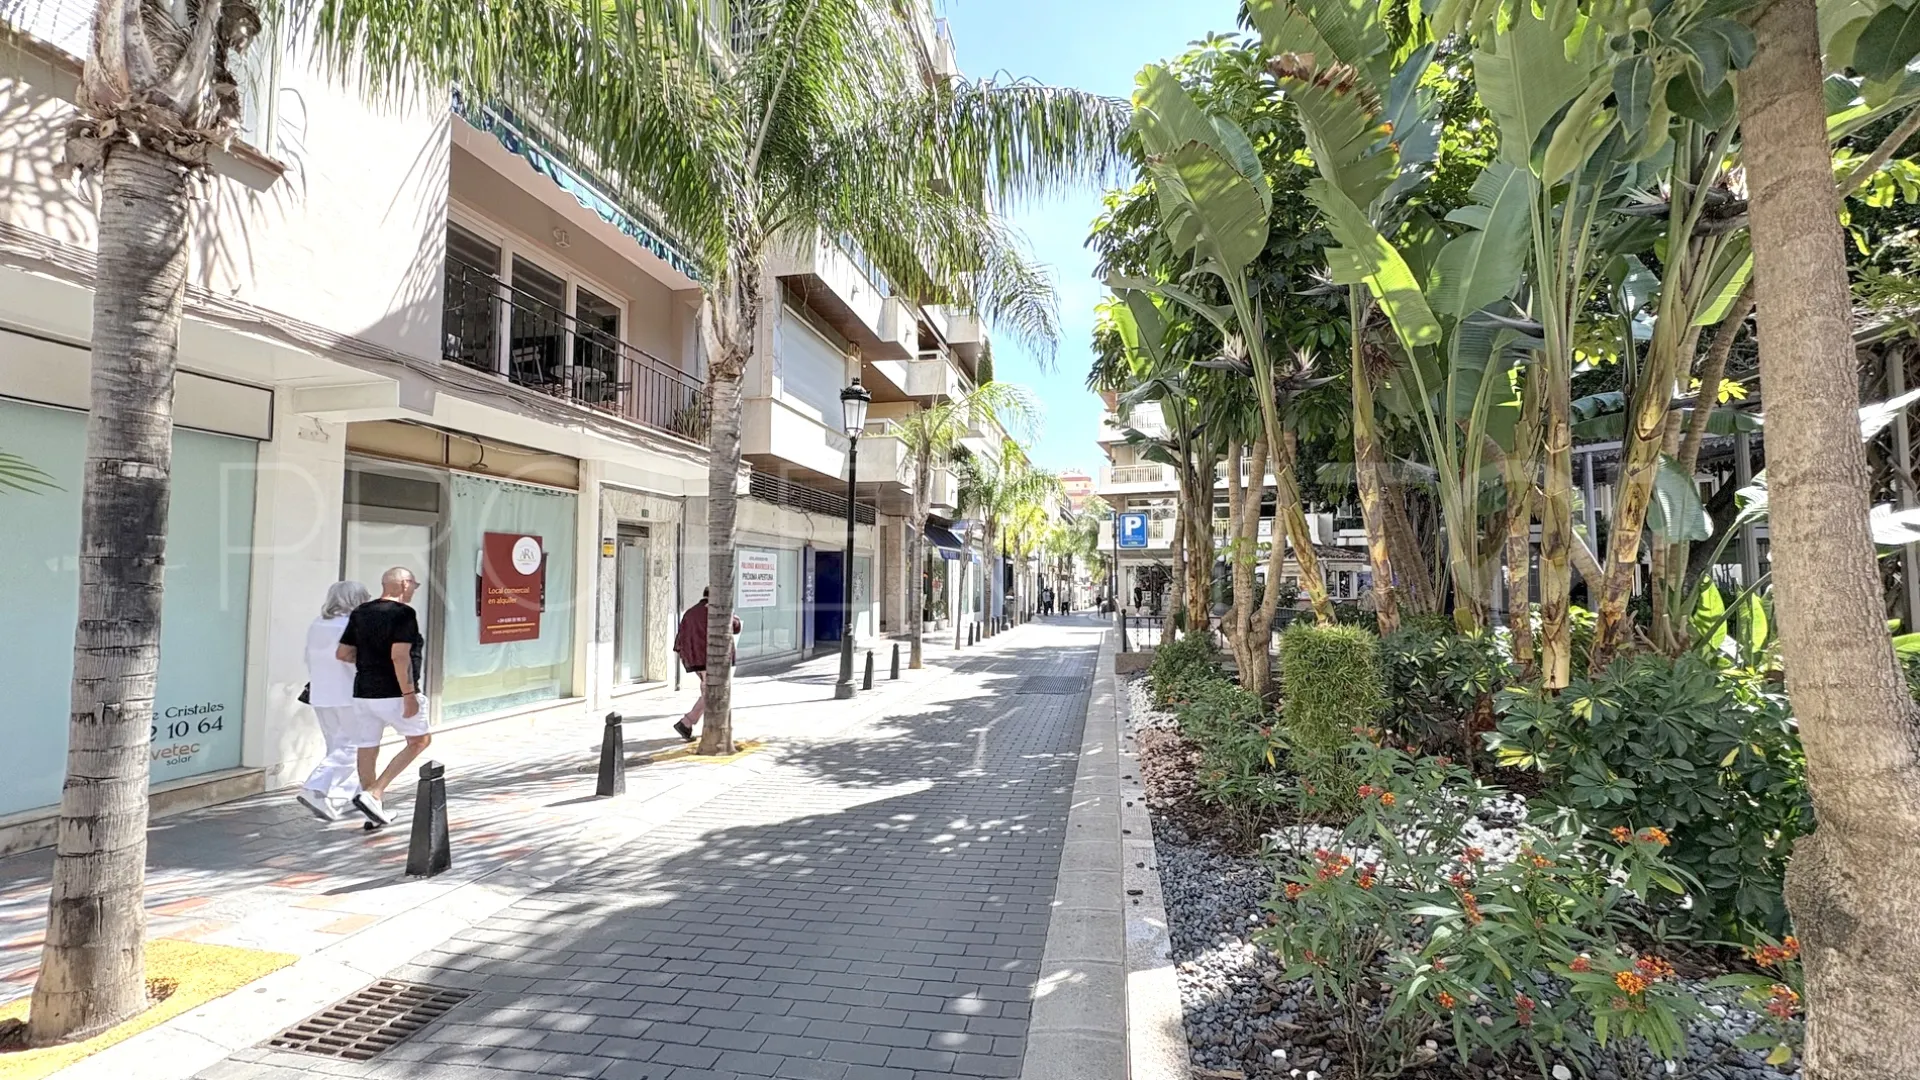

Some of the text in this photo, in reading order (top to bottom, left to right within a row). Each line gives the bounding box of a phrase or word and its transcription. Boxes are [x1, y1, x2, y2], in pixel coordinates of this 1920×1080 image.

[1125, 516, 1142, 536] P
[488, 586, 530, 595] Local comercial
[497, 596, 517, 605] alquiler
[165, 702, 224, 718] Cristales
[167, 721, 189, 739] 10
[198, 715, 223, 734] 64
[151, 743, 200, 761] vetec
[166, 755, 192, 766] solar
